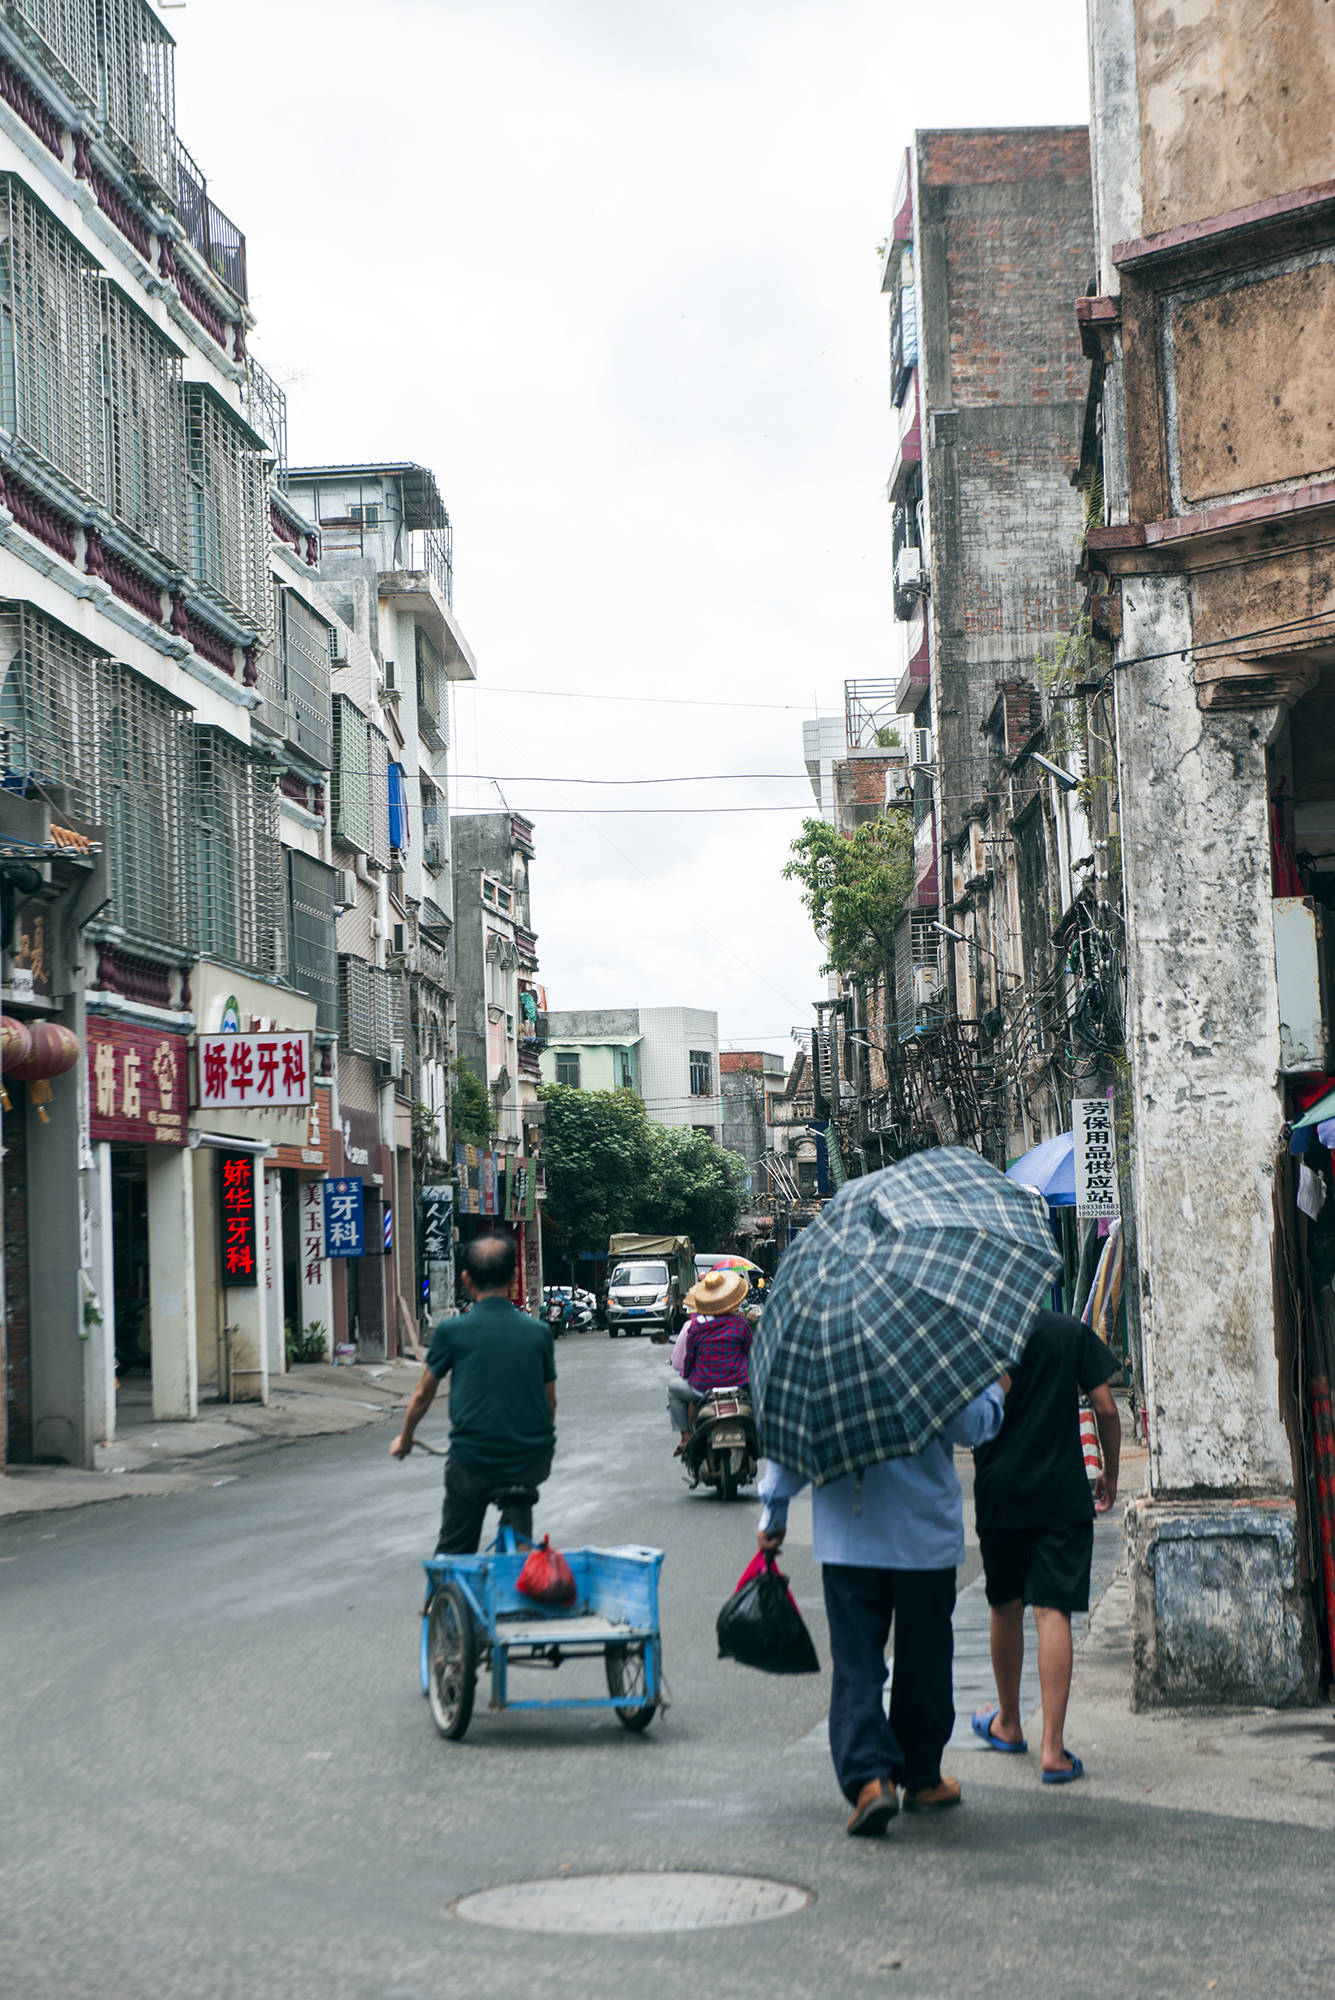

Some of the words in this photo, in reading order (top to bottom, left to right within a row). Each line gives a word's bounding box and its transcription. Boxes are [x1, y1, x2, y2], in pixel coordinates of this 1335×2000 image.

[204, 1040, 306, 1099] 娇华牙科
[1083, 1102, 1113, 1203] 劳保用品供应站
[223, 1159, 254, 1274] 娇华牙科
[304, 1185, 322, 1285] 美玉牙科
[330, 1196, 360, 1247] 牙科
